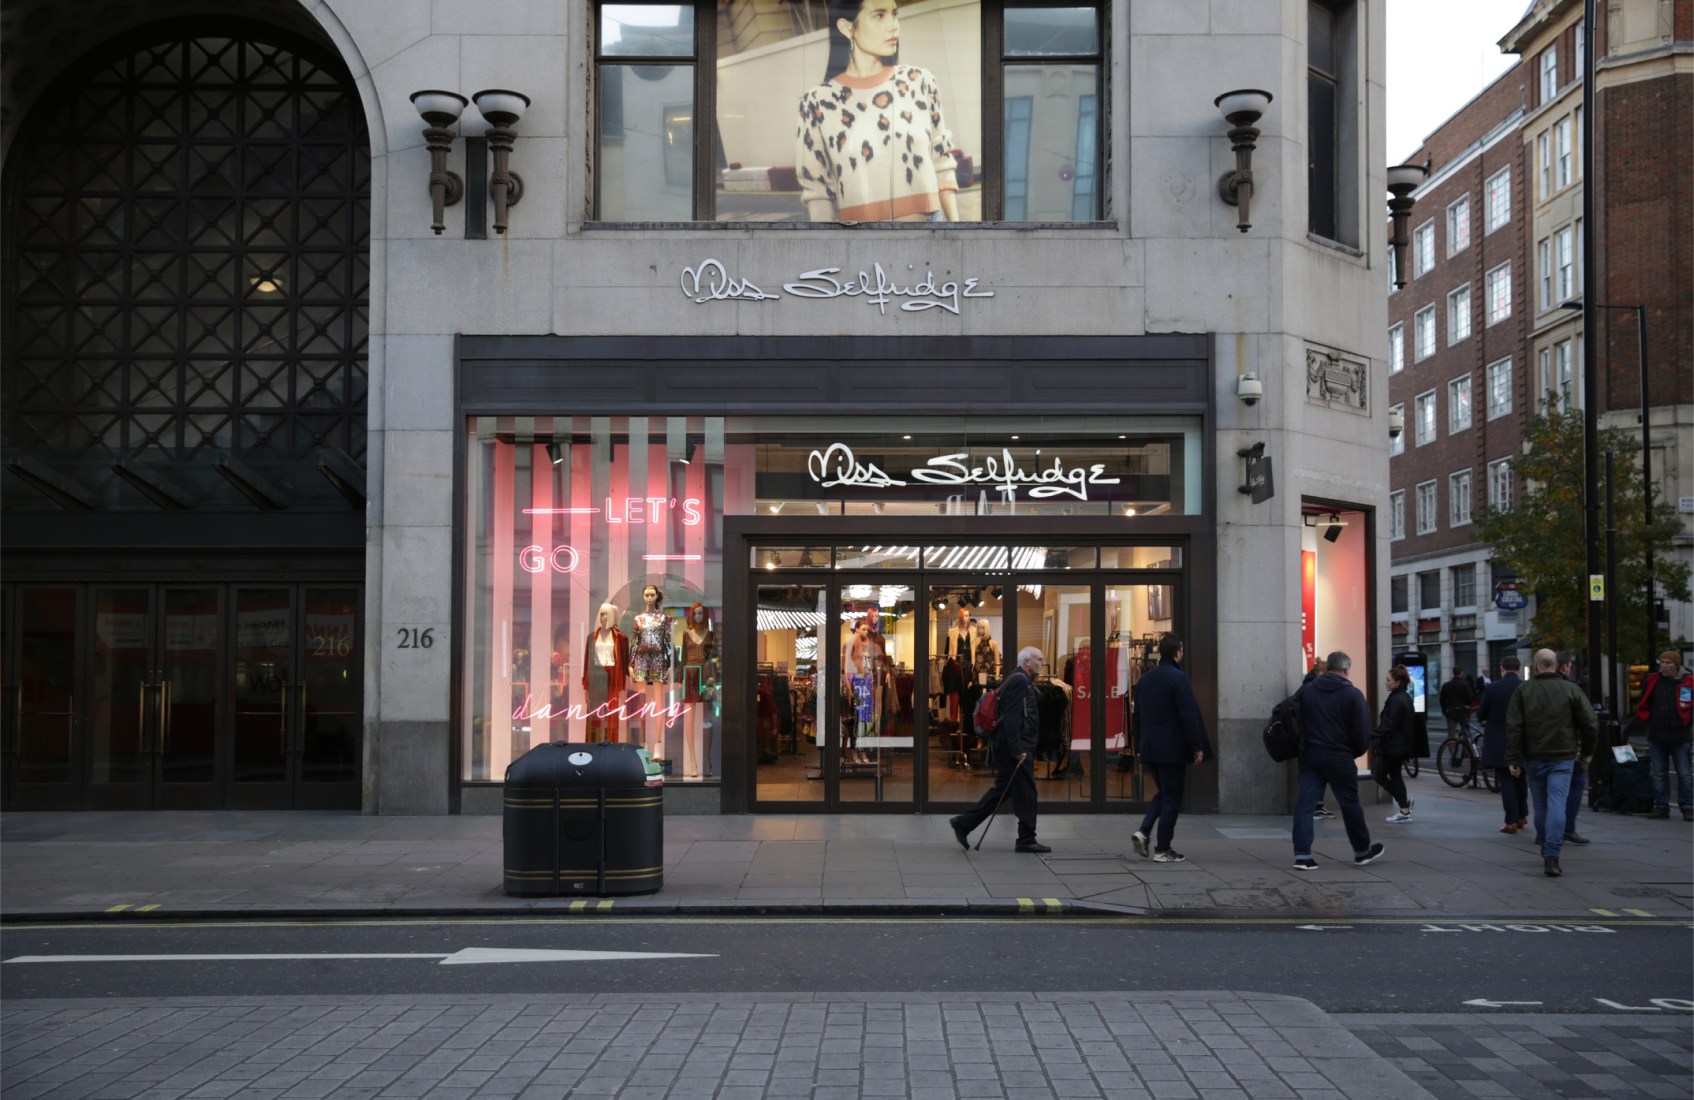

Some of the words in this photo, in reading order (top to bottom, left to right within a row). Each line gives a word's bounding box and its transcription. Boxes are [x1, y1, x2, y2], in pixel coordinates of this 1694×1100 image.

[681, 258, 780, 303] Miss
[783, 262, 994, 315] Selfridge
[808, 443, 906, 488] Miss
[911, 448, 1120, 501] Selfridge
[605, 497, 701, 526] LET'S
[519, 545, 579, 573] GO
[312, 635, 350, 656] 216
[396, 627, 434, 649] 216
[511, 689, 692, 728] dancing
[1419, 923, 1617, 933] RIGHT
